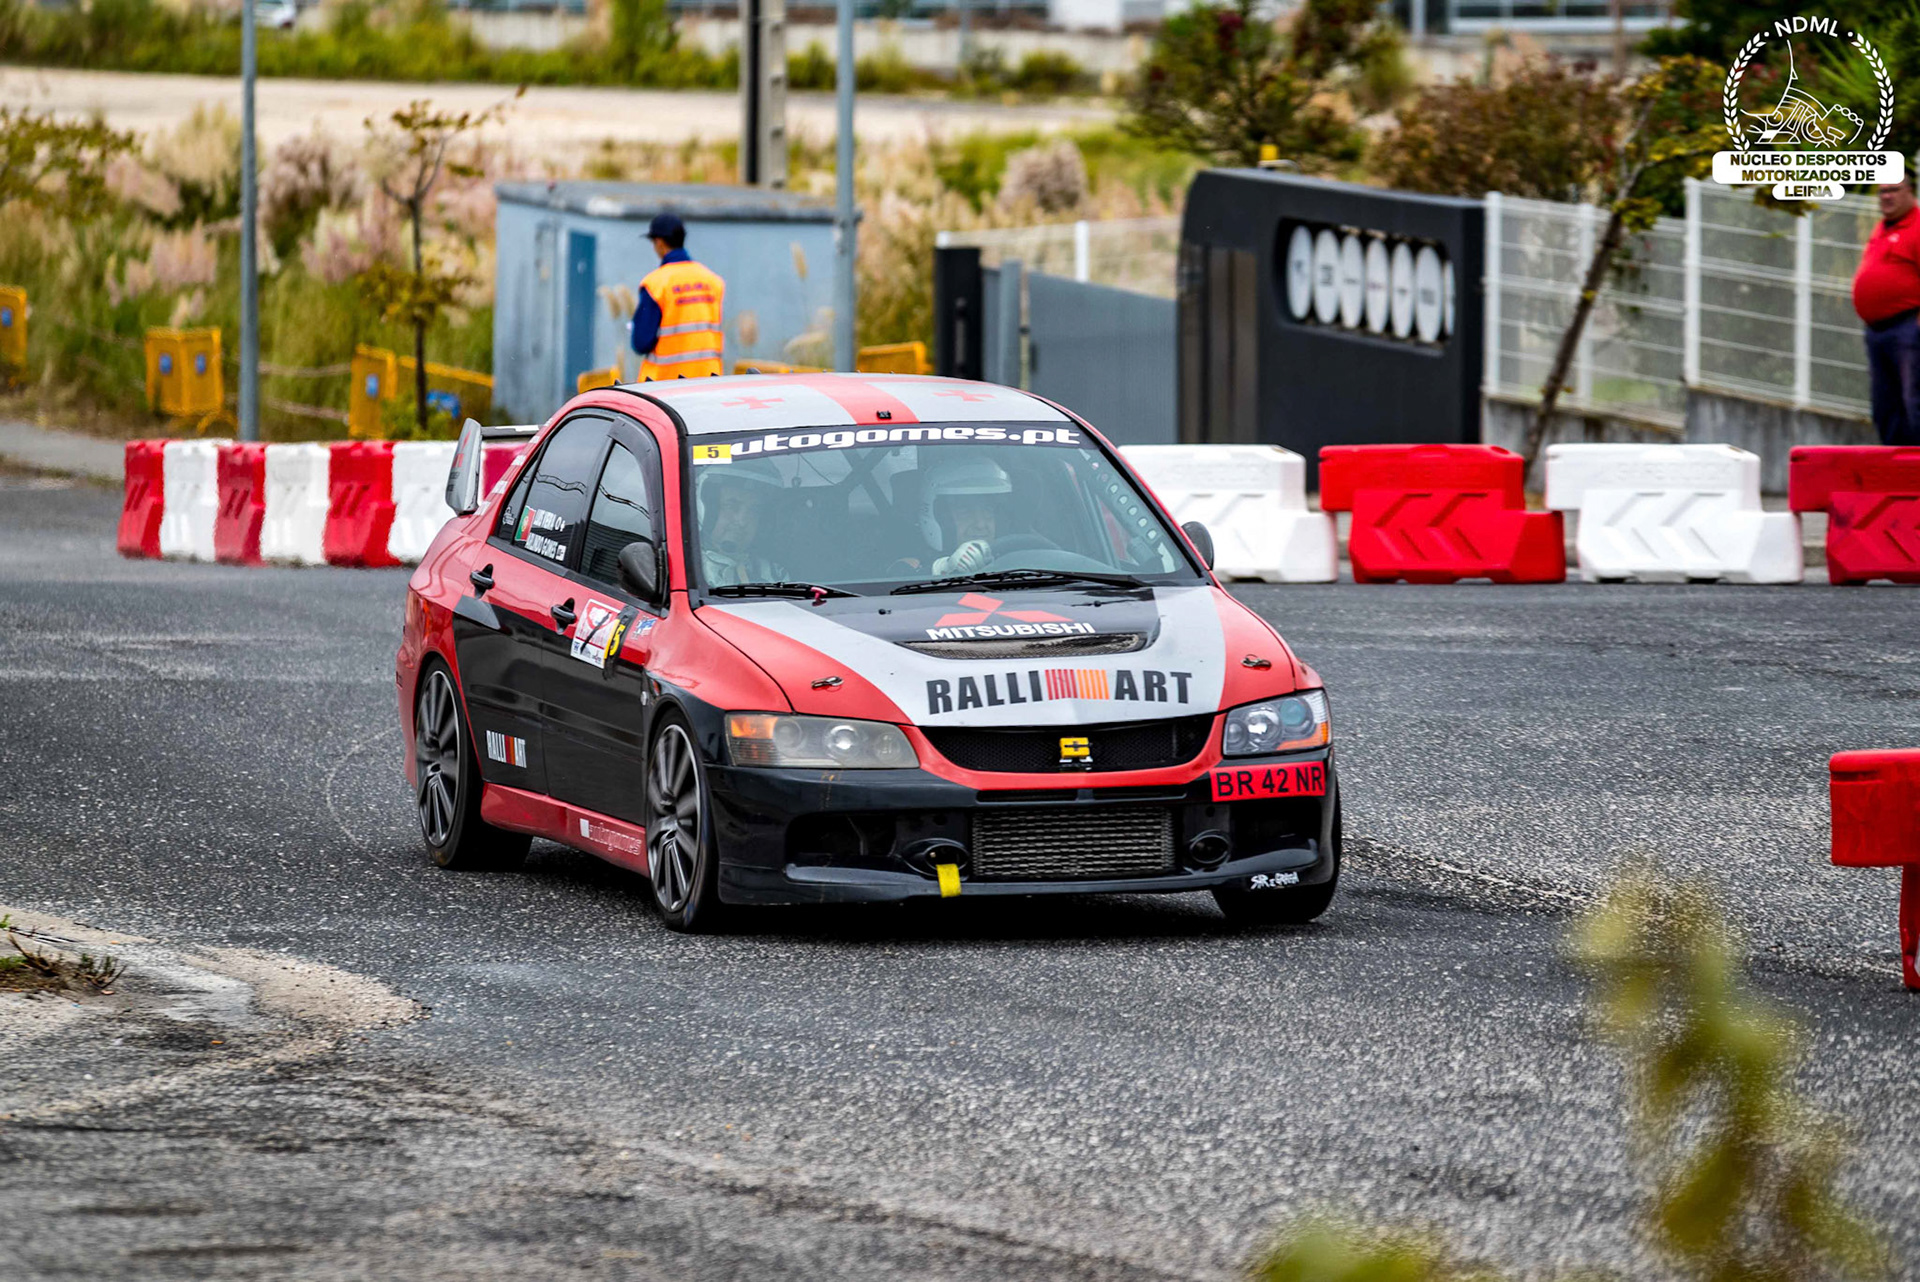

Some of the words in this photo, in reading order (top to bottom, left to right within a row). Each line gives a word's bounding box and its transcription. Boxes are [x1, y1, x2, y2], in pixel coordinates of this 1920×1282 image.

[707, 446, 720, 459] 5
[730, 427, 1081, 456] utogomes.pt
[609, 624, 626, 656] 5
[925, 622, 1096, 641] MITSUBISHI
[1216, 770, 1255, 797] BR
[1262, 768, 1289, 794] 42
[1295, 766, 1323, 792] NR
